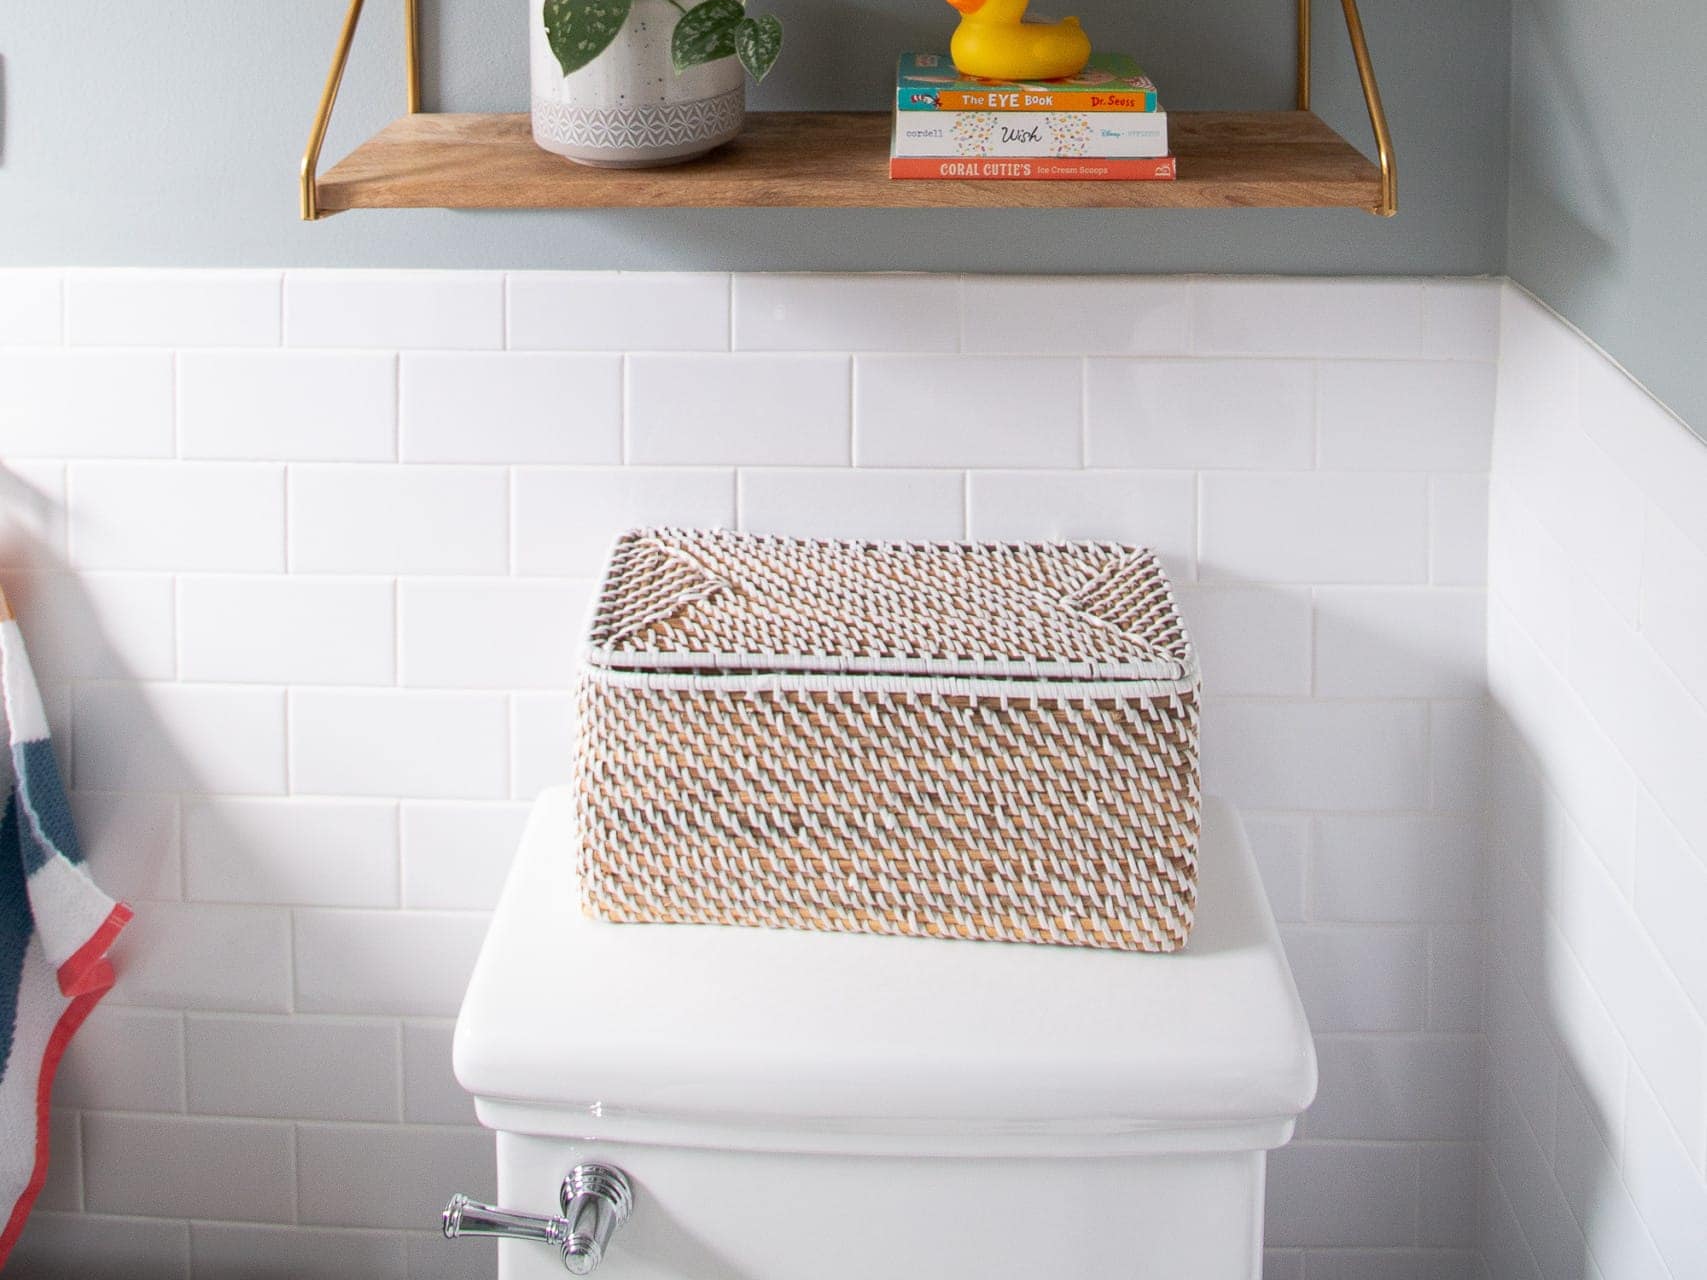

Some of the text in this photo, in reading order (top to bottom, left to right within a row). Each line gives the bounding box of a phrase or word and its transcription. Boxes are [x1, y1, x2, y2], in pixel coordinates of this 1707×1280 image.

[962, 94, 984, 106] The
[988, 93, 1020, 108] EYE
[1091, 96, 1106, 107] Dr.
[1107, 95, 1136, 108] Seuss
[906, 129, 944, 138] cordell
[1001, 126, 1042, 144] Wish
[940, 163, 1108, 176] CORAL CUTIE'S Ice Cream Scoops
